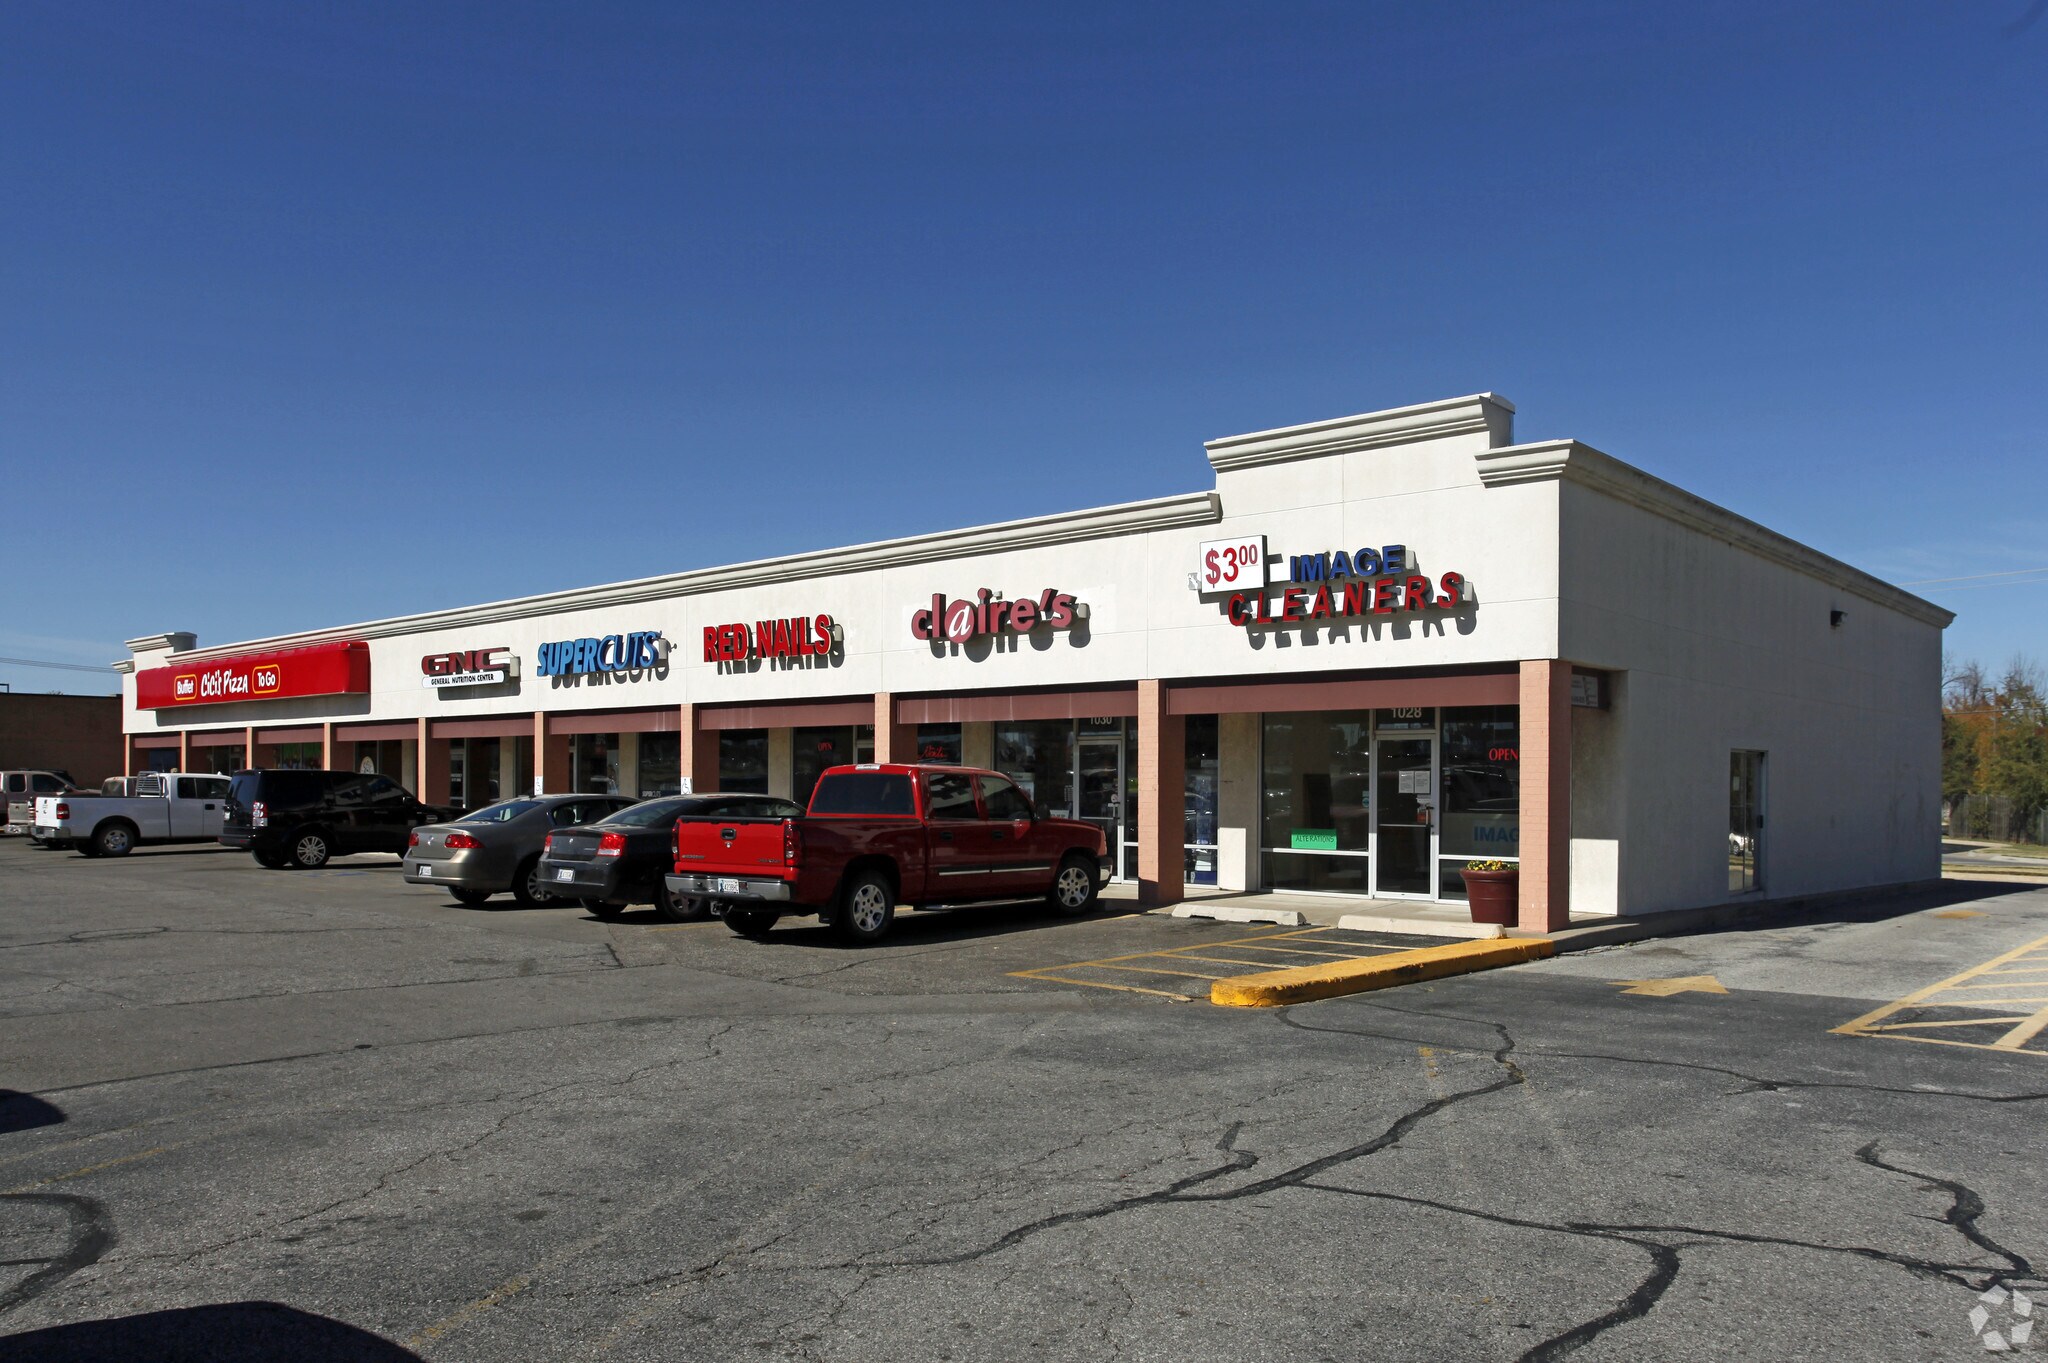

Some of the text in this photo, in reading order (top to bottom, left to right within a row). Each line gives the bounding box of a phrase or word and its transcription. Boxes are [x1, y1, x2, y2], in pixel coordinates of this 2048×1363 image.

[1290, 545, 1404, 583] IMAGE
[1228, 571, 1461, 626] CLEANERS
[911, 588, 1075, 643] claire's
[703, 614, 832, 662] RED NAILS
[421, 647, 509, 675] GNC
[537, 630, 660, 677] SUPERCUTS
[176, 679, 194, 695] Buffet
[257, 671, 276, 687] To Go
[431, 673, 494, 685] GENERAL NUTRITION CENTER
[1391, 707, 1423, 719] 1028
[1488, 747, 1519, 762] OPEN
[1295, 834, 1335, 844] ALTERATIONS
